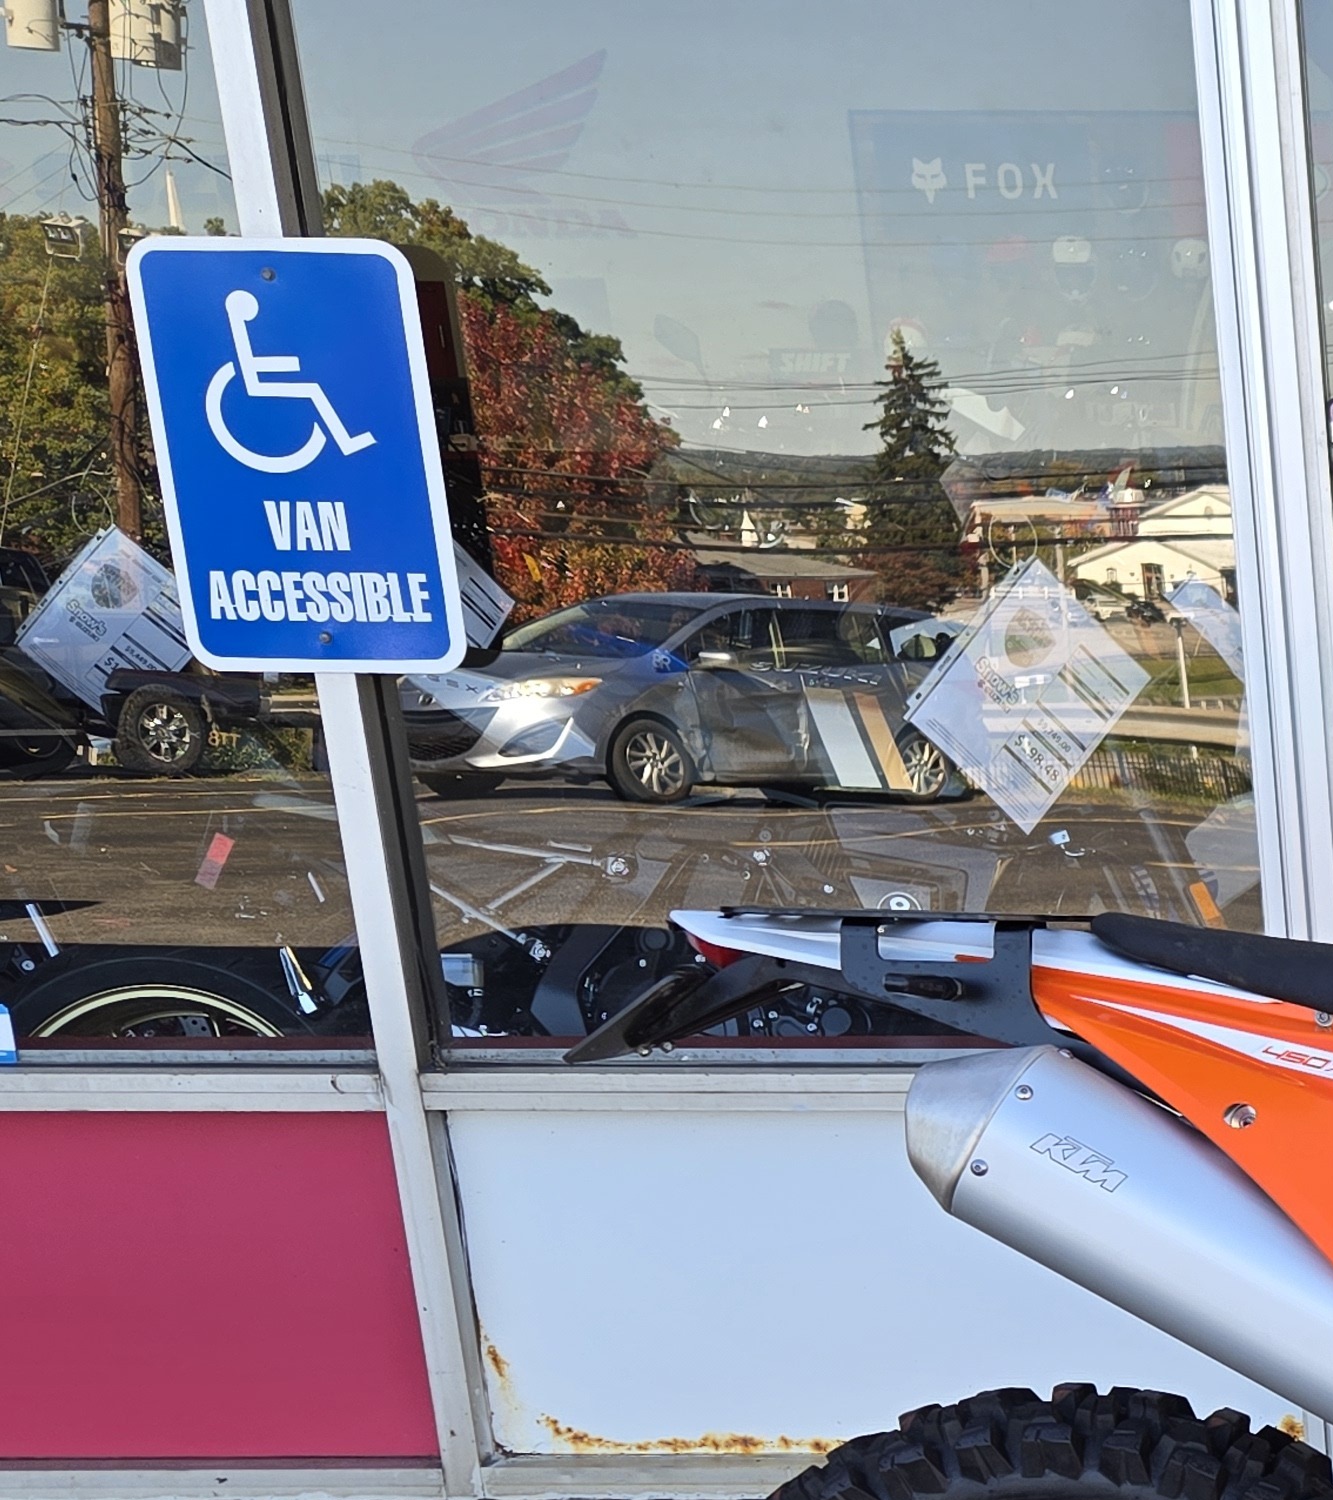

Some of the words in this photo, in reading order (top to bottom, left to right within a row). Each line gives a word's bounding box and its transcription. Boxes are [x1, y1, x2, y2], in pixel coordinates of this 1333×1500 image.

[964, 162, 1059, 200] FOX
[264, 500, 350, 552] VAN
[66, 598, 107, 637] Snow's
[209, 569, 433, 624] ACCESSIBLE
[974, 656, 1020, 705] Snow's
[1030, 1132, 1129, 1194] KTM
